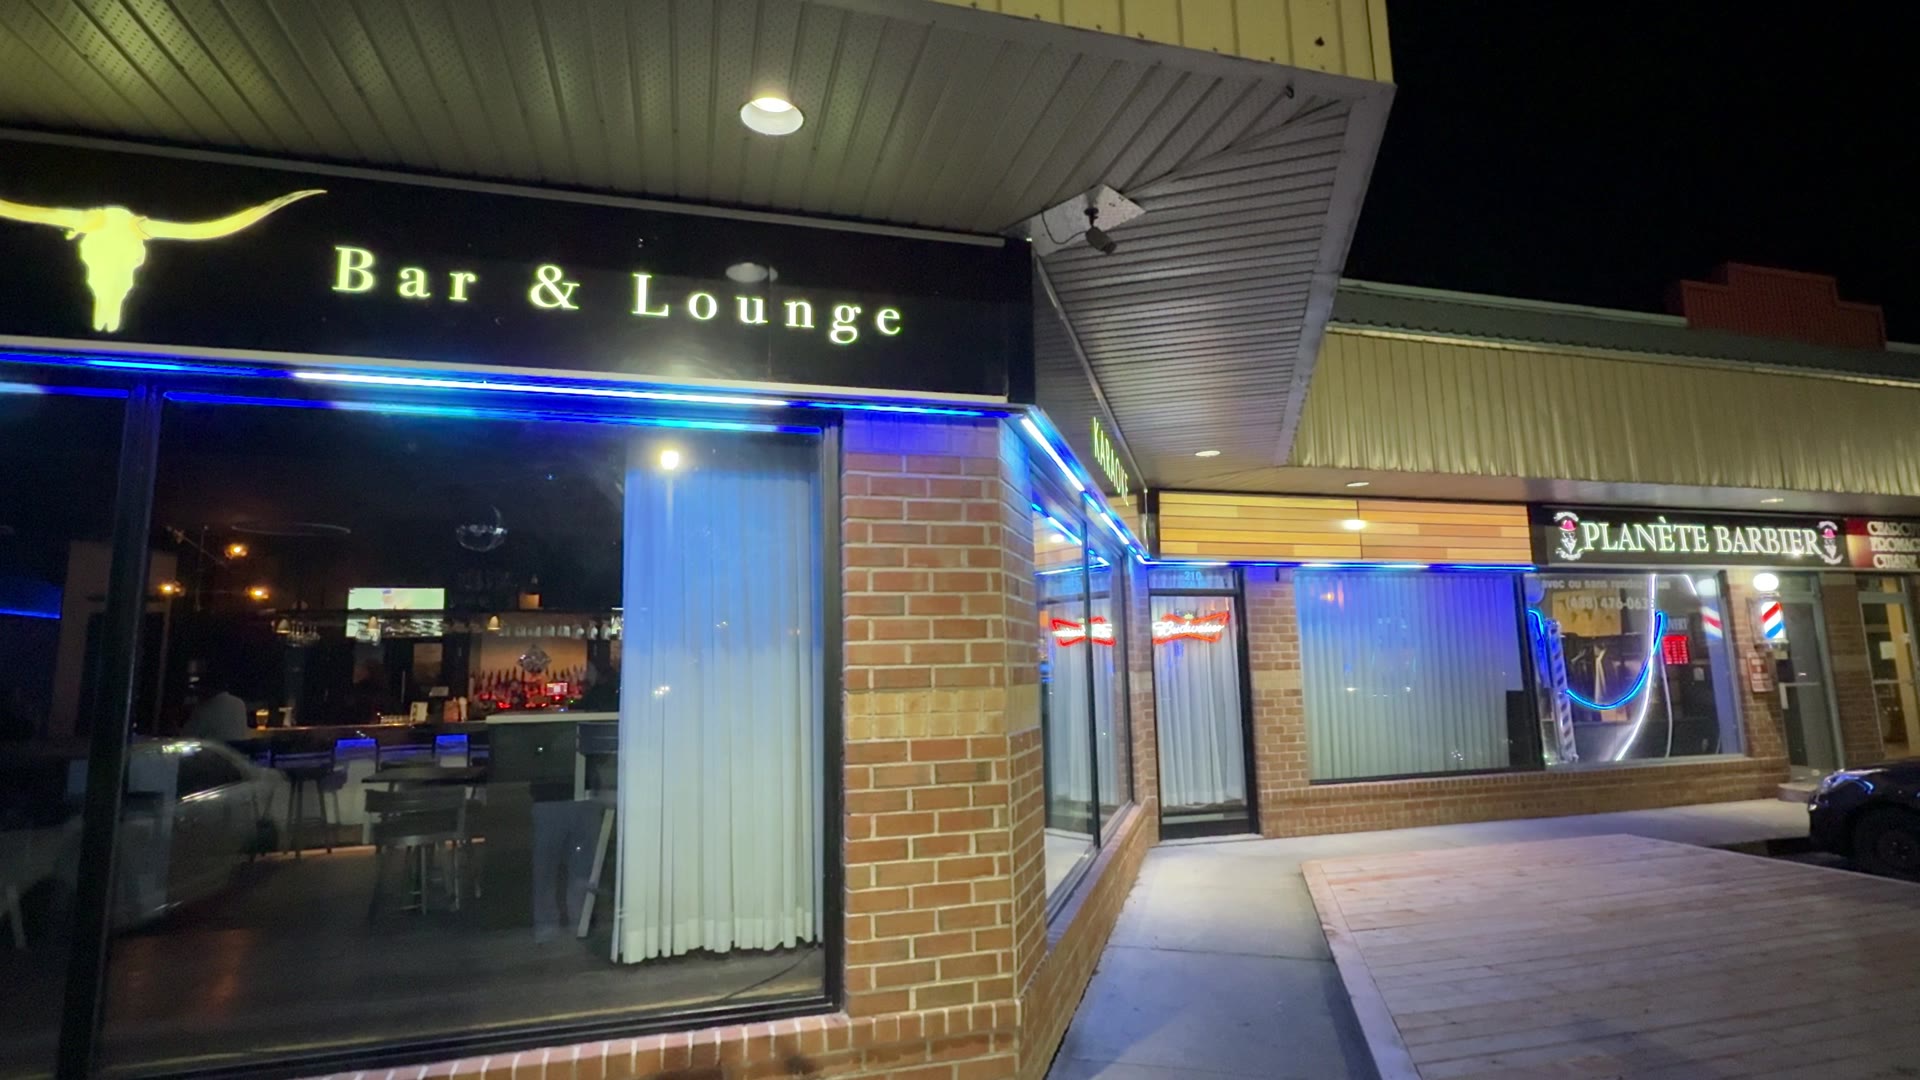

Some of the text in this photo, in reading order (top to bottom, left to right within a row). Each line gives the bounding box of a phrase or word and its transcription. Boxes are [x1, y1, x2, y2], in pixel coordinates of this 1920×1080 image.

[332, 245, 904, 345] Bar & Lounge
[1092, 415, 1129, 507] KARAOKE
[1581, 515, 1822, 556] PLANÈTE BARBIER
[1184, 570, 1202, 581] 210
[1568, 579, 1582, 589] ou
